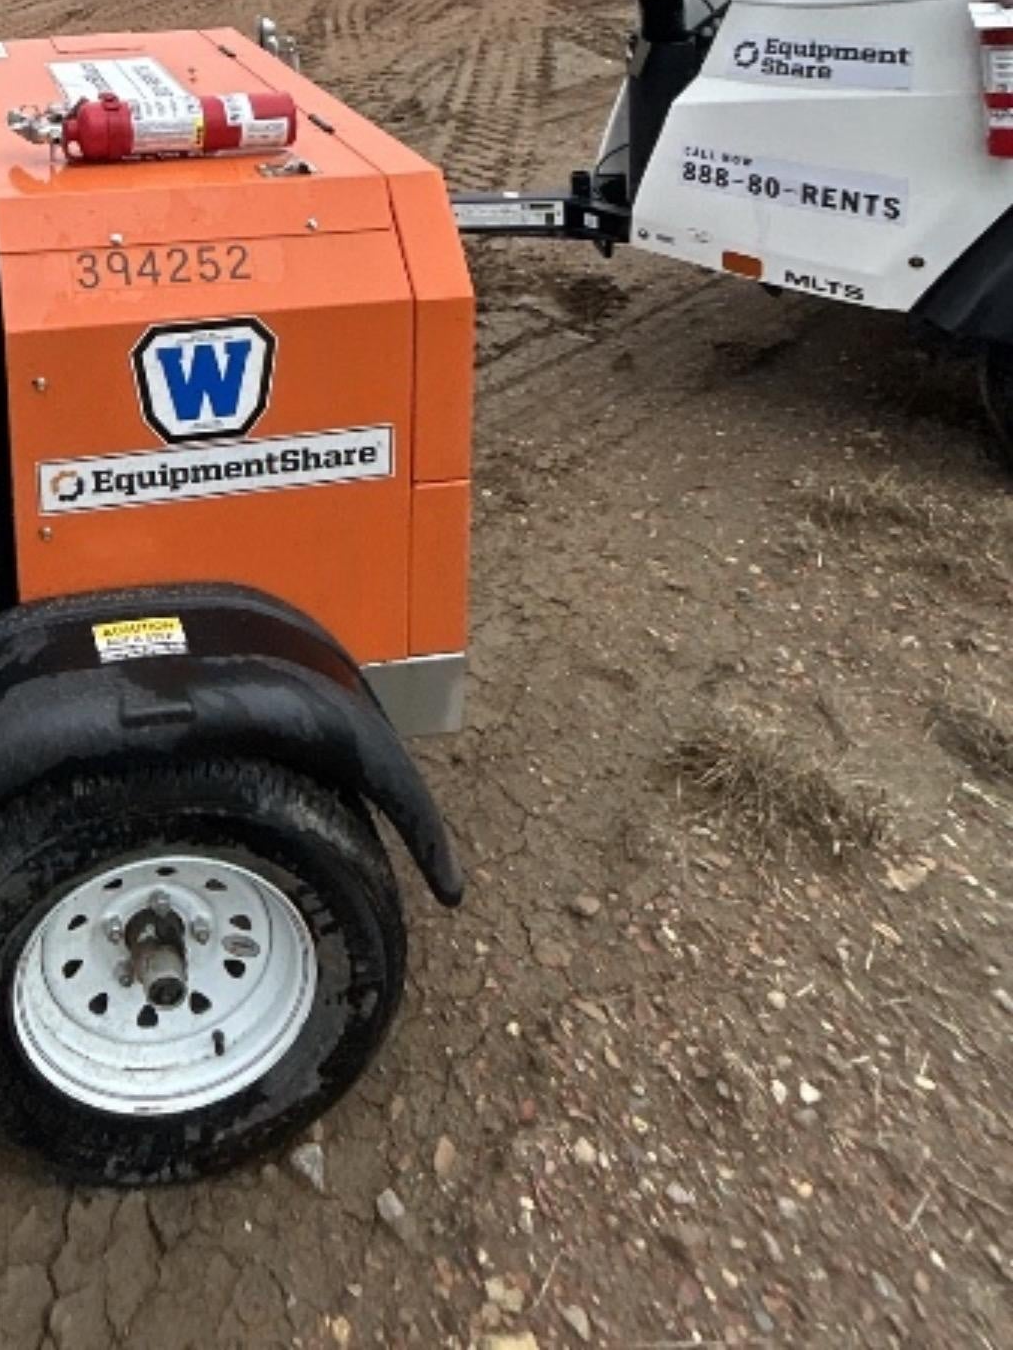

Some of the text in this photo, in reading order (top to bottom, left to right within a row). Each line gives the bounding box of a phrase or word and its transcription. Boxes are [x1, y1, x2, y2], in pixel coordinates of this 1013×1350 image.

[760, 56, 832, 80] Share
[763, 37, 911, 66] Equipment
[682, 161, 901, 220] 888-80-RENTS
[76, 244, 252, 289] 394252
[155, 339, 252, 421] W
[91, 445, 377, 497] EquipmentShare
